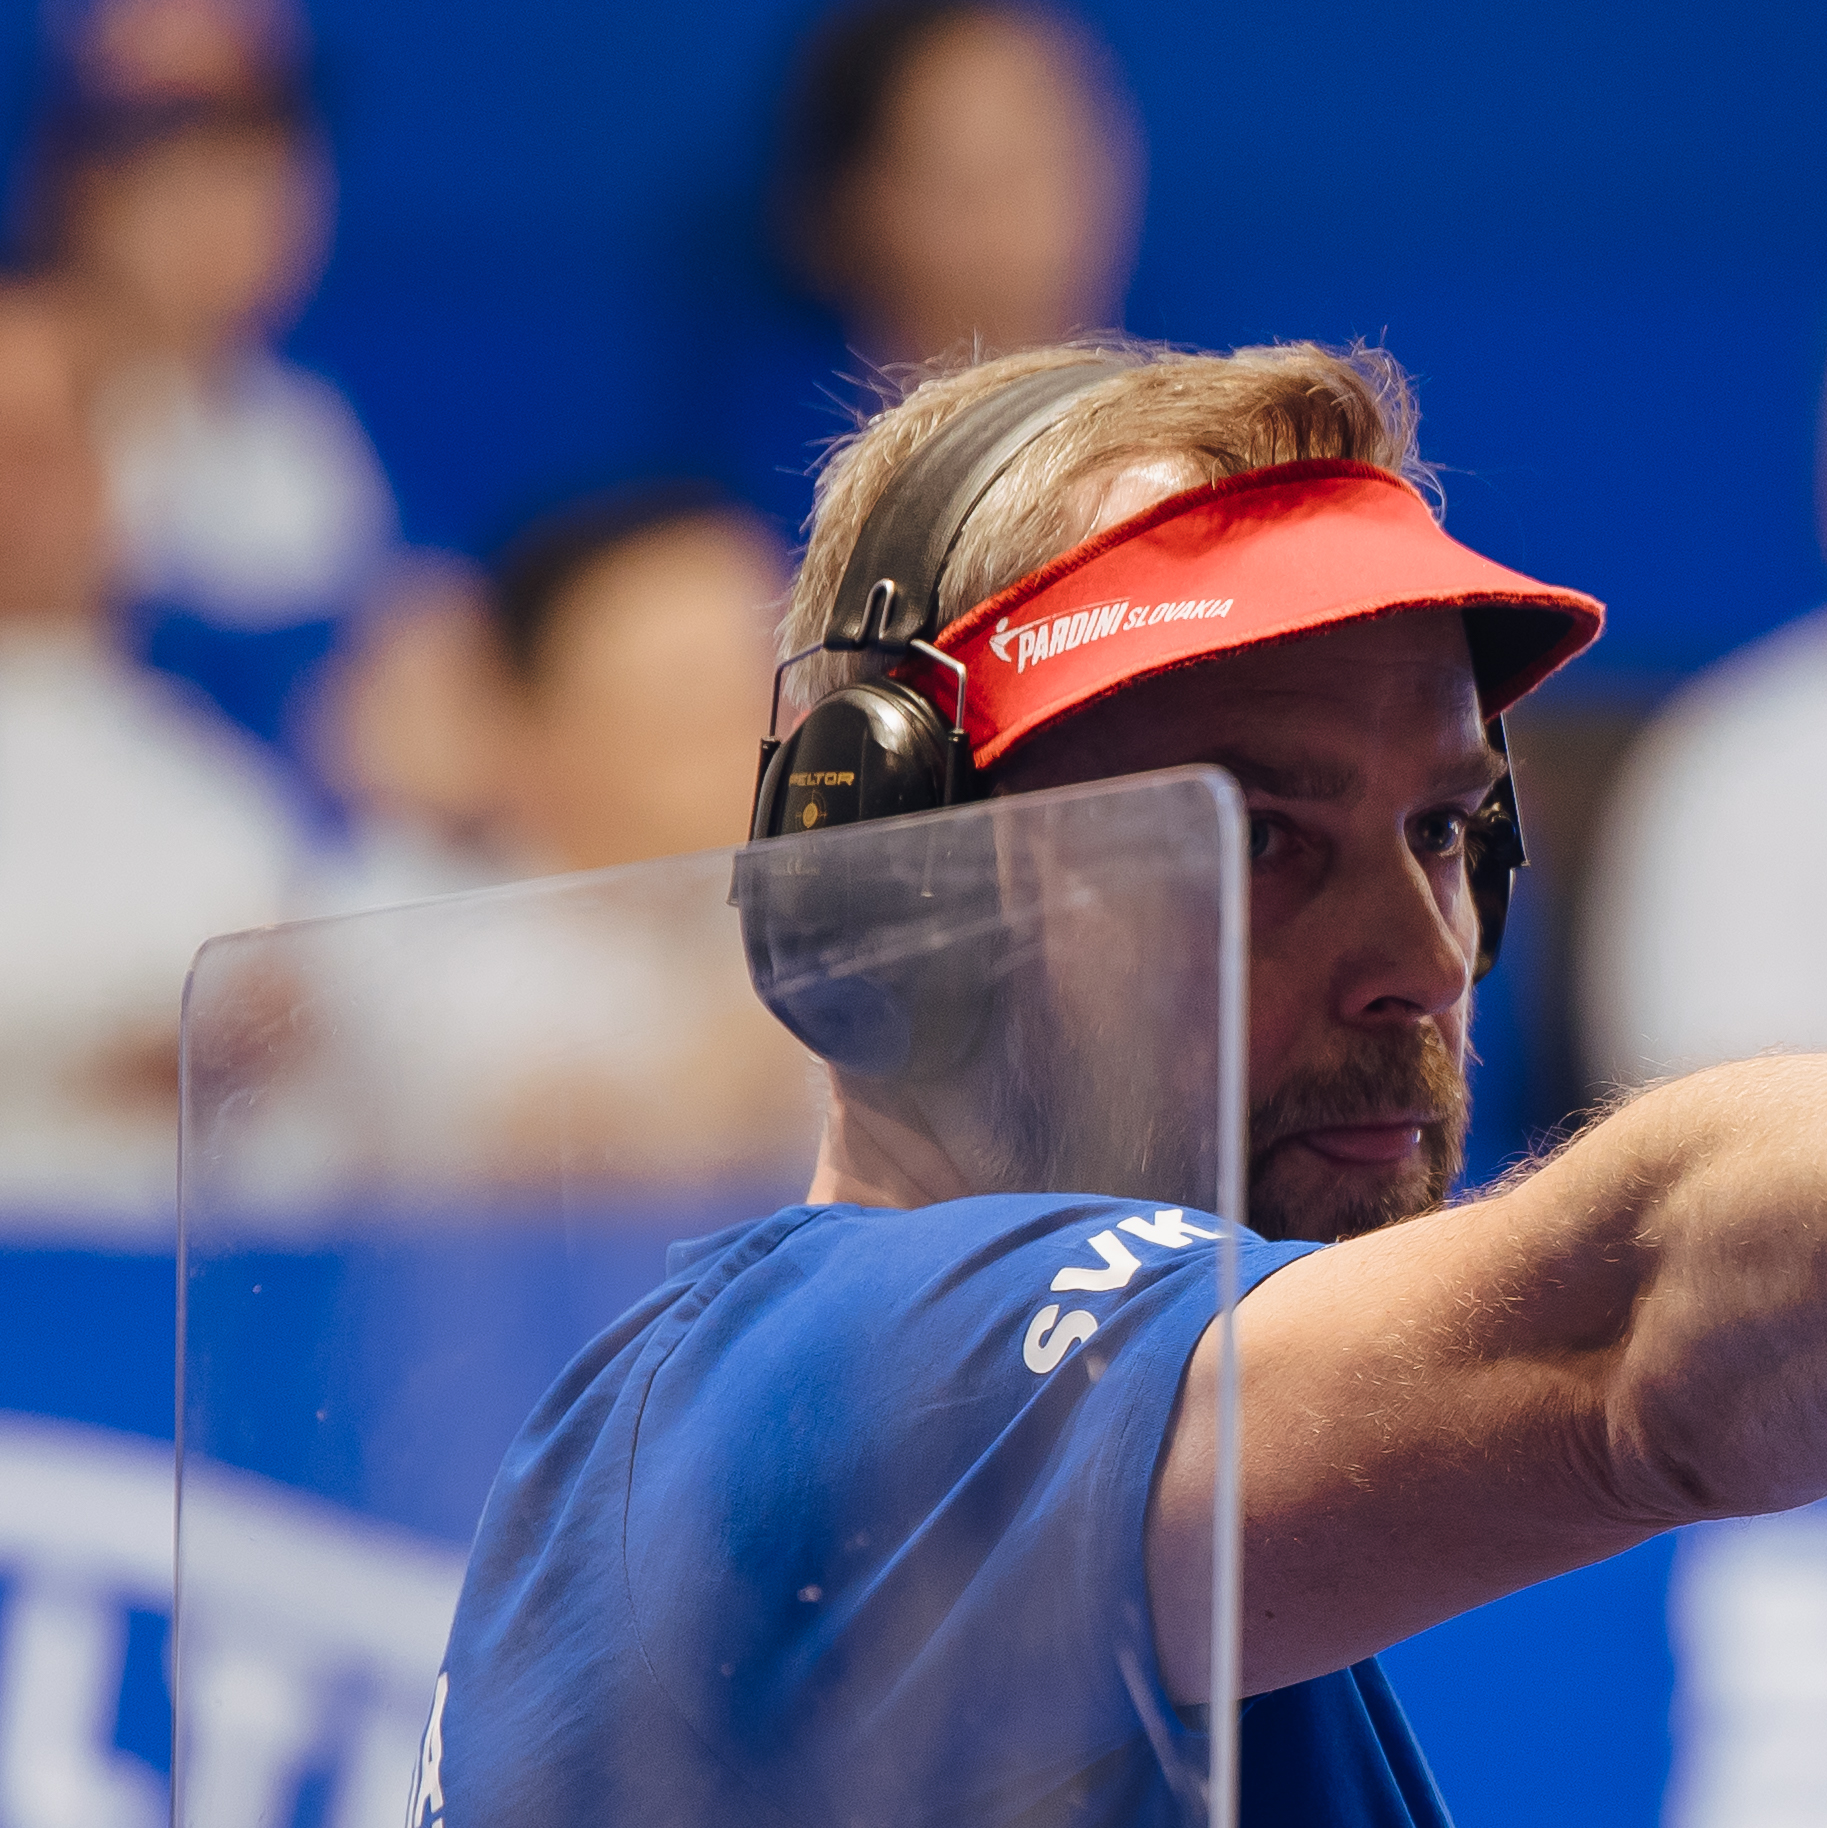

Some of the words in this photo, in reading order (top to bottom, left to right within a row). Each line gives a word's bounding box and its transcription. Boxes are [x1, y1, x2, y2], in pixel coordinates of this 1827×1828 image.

[1017, 600, 1130, 675] PARDINI
[1123, 598, 1235, 632] SLOVAKIA
[788, 771, 856, 787] PELTOR
[1022, 1208, 1234, 1375] SVK
